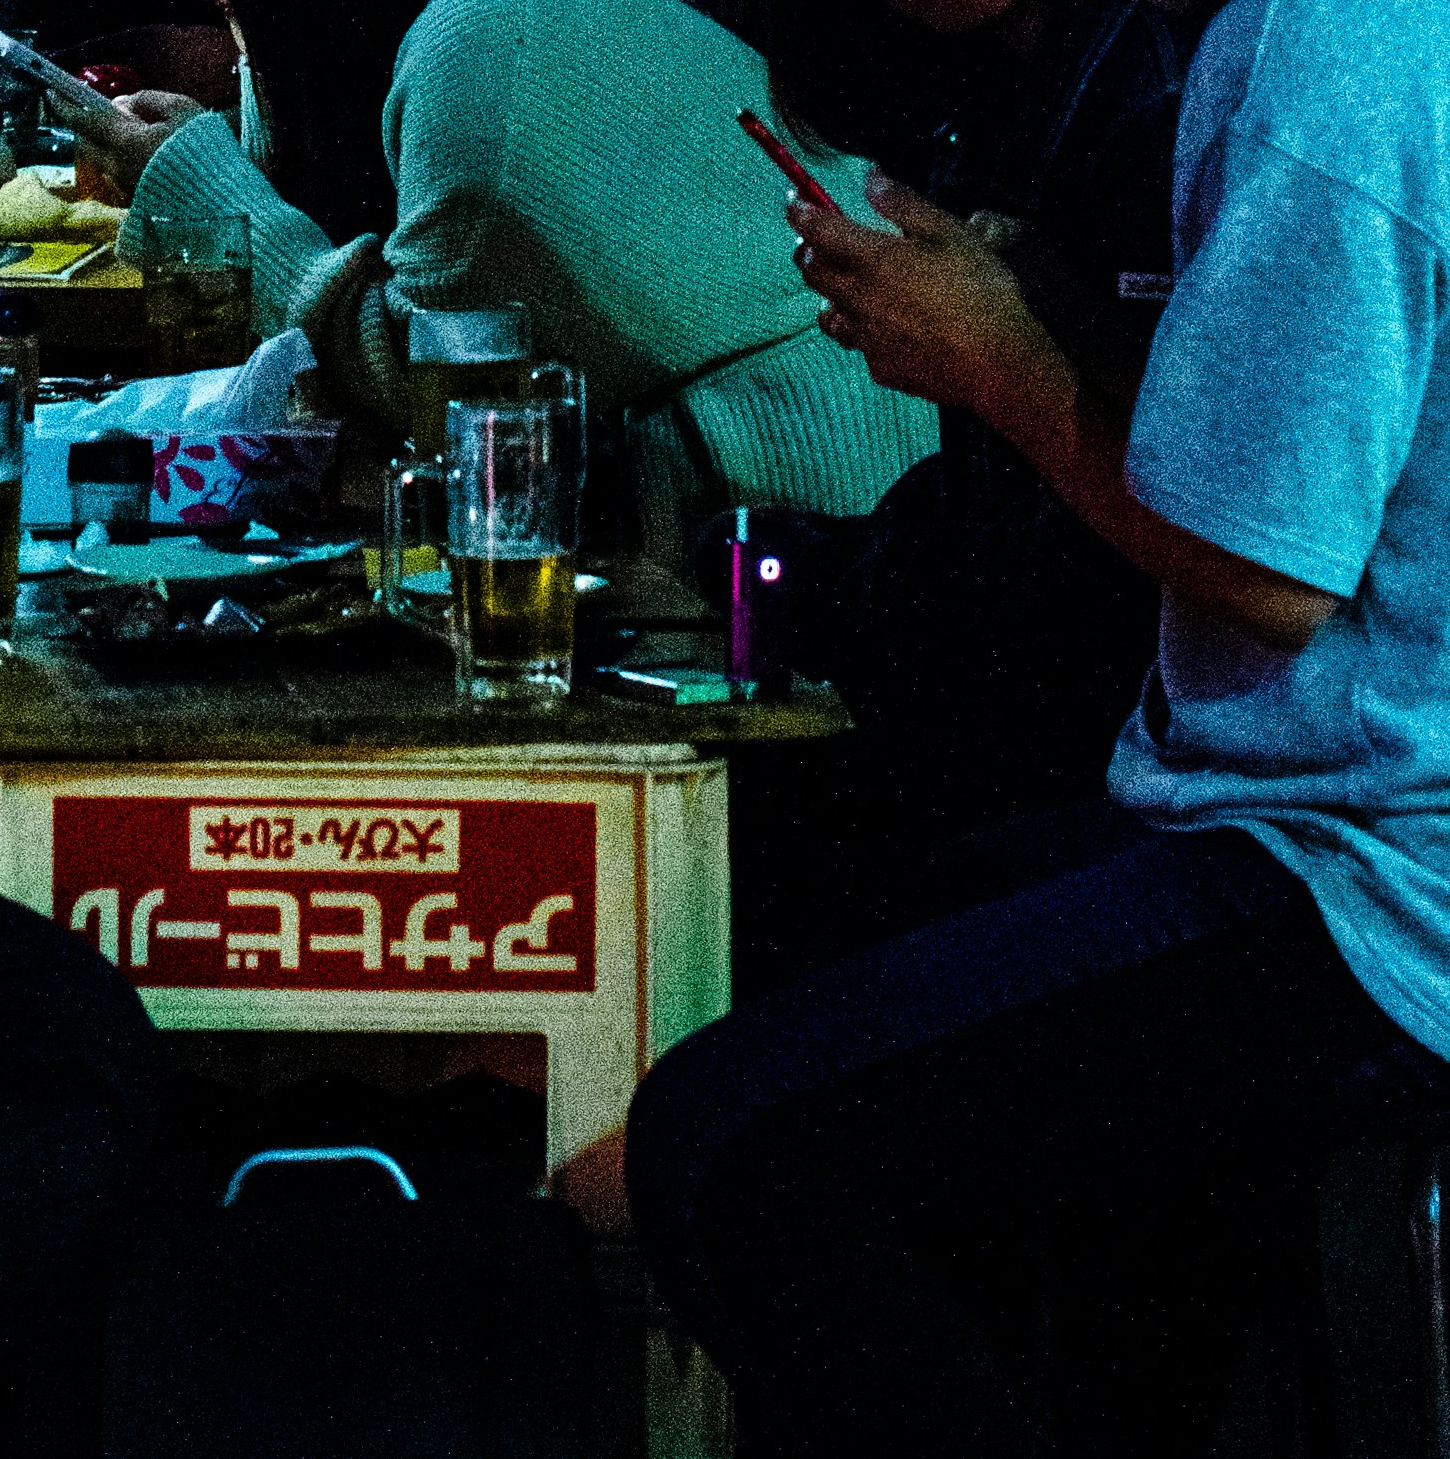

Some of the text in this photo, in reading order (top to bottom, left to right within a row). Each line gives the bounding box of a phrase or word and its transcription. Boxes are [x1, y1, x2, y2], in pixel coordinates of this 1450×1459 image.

[69, 887, 578, 971] アサヒビール
